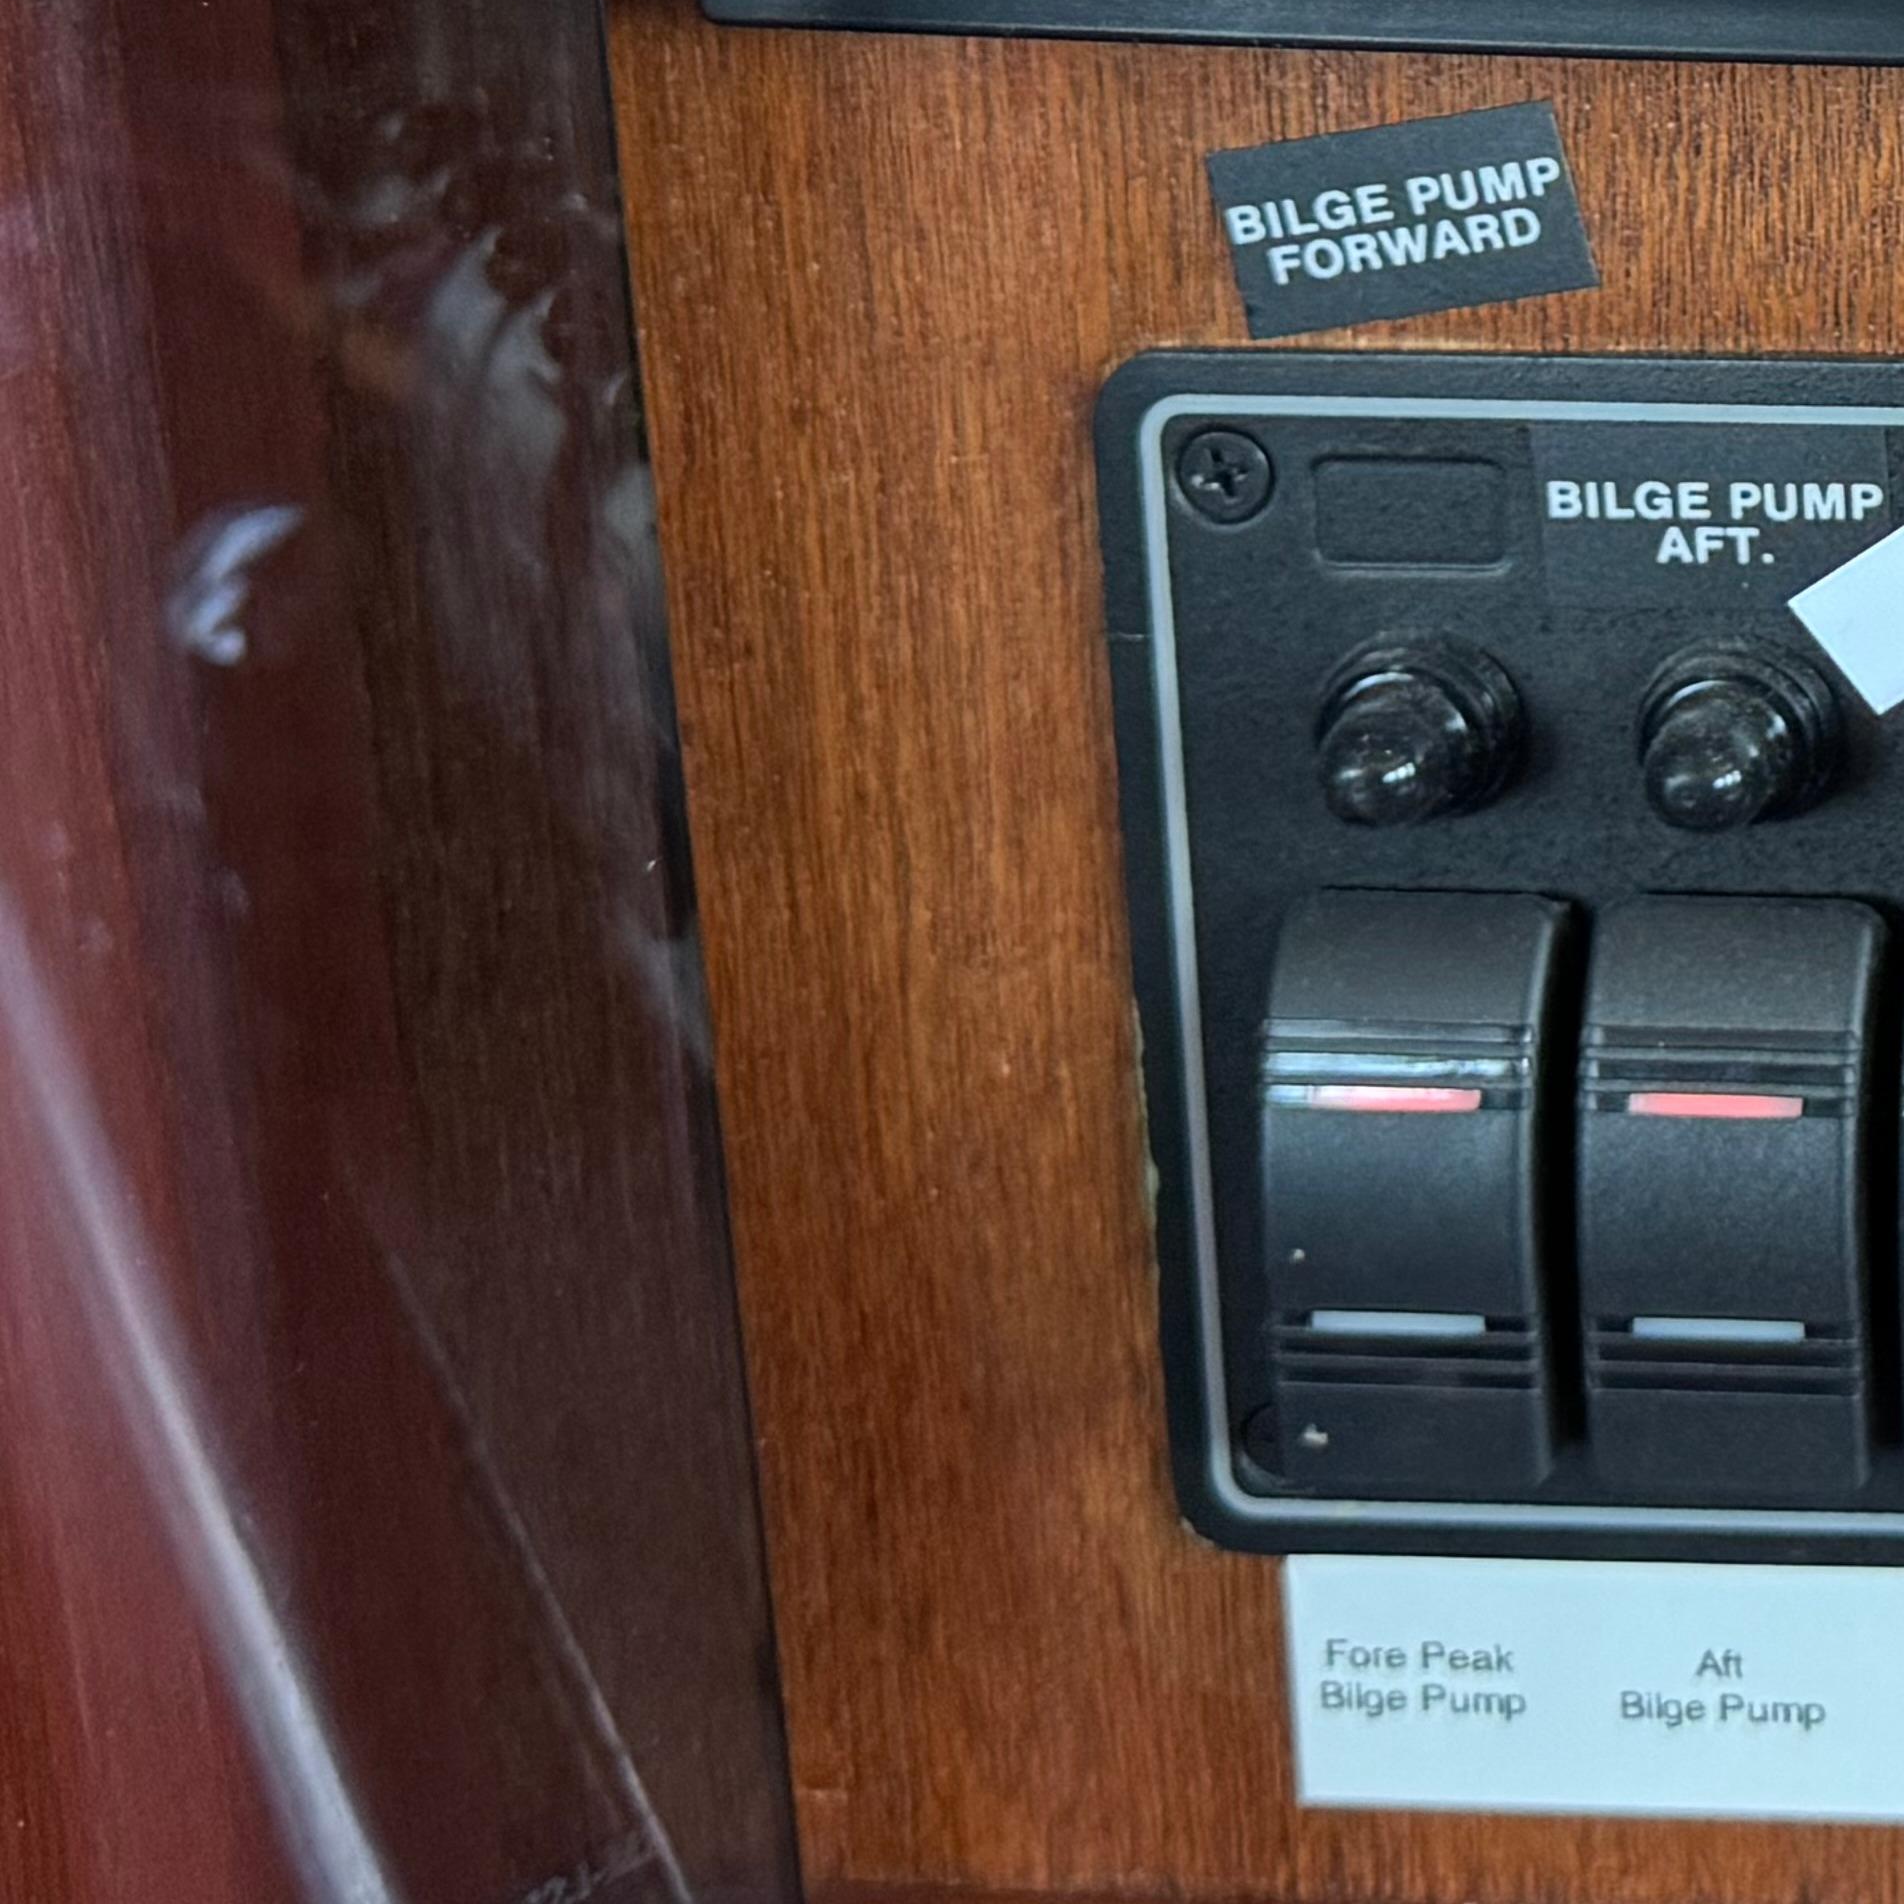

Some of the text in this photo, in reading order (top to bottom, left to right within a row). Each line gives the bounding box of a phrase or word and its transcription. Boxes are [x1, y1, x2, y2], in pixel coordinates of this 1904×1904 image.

[1225, 156, 1561, 246] BILGE PUMP
[1267, 207, 1543, 286] FORWARD
[1546, 480, 1884, 522] BILGE PUMP
[1655, 527, 1775, 565] AFT.
[1325, 1639, 1514, 1673] Fore Peak
[1695, 1649, 1743, 1680] Aft
[1320, 1681, 1527, 1722] Bilge Pump
[1621, 1690, 1826, 1731] Bilge Pump
